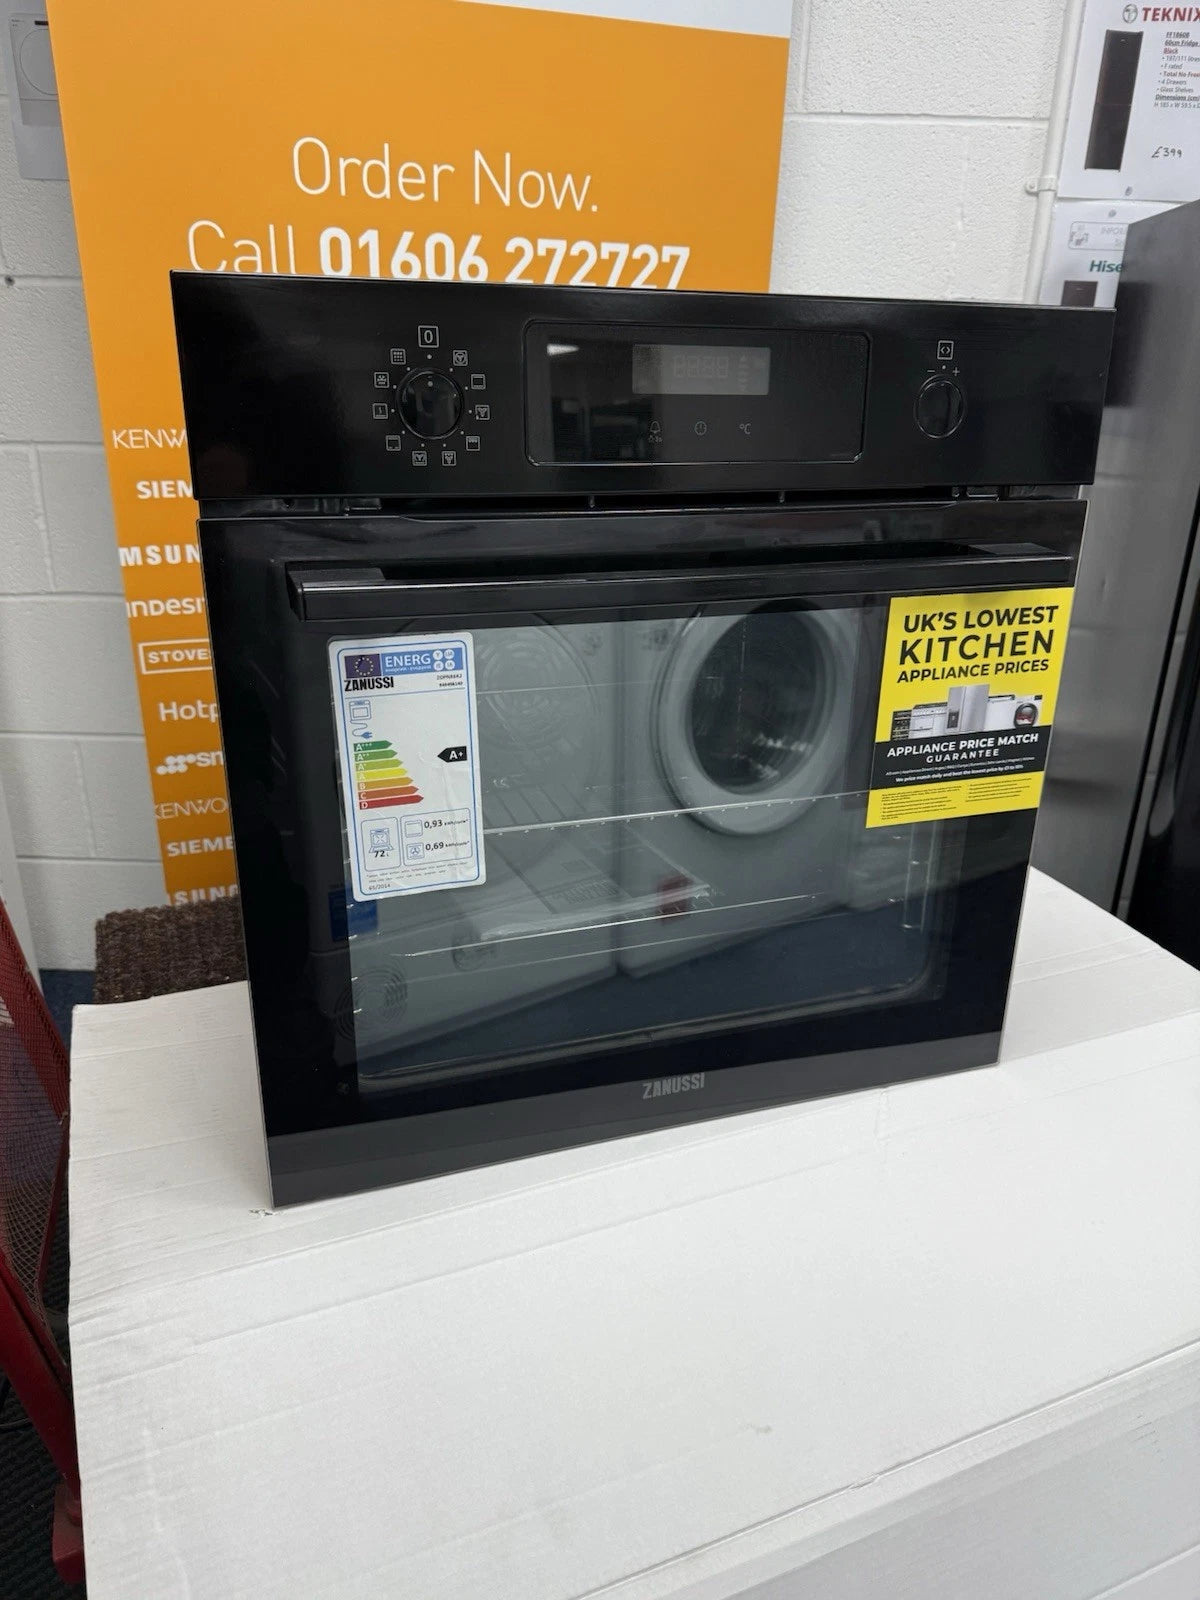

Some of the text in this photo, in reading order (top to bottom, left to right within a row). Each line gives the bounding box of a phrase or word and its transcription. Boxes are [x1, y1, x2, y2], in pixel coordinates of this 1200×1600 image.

[1151, 146, 1182, 158] £399
[292, 137, 598, 212] Order Now.
[187, 220, 690, 290] Call 01606 272727
[1089, 260, 1124, 272] Hise
[904, 606, 1059, 633] UK'S LOWEST
[899, 629, 1054, 665] KITCHEN
[148, 648, 212, 664] STOVE
[385, 654, 431, 668] ENERG
[897, 659, 1049, 683] APPLIANCE PRICES
[345, 676, 394, 692] ZANUSSI
[159, 700, 219, 723] Hotp
[887, 733, 1039, 758] APPLIANCE PRICE MATCH
[449, 751, 463, 759] A+
[926, 749, 999, 763] GUARANTEE
[424, 820, 443, 829] 0,93
[425, 842, 444, 851] 0,69
[643, 1072, 705, 1099] ZANUSSI
